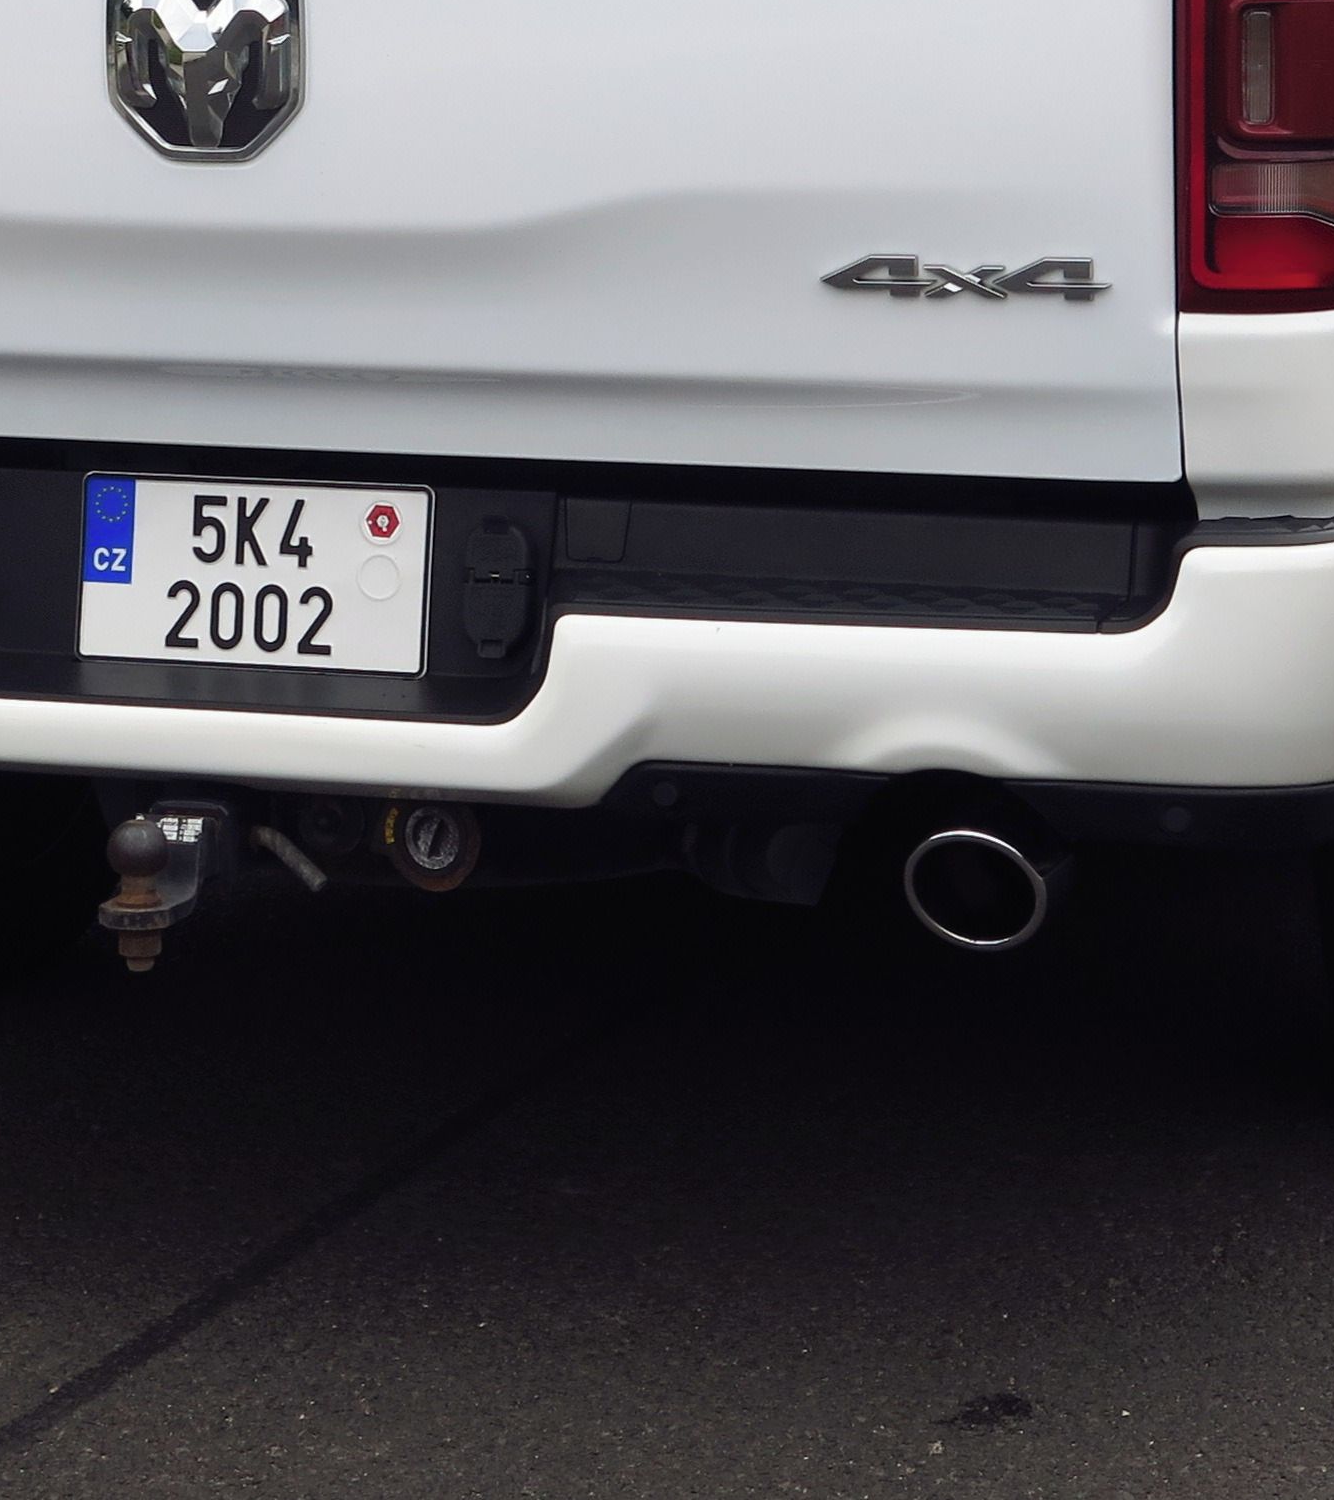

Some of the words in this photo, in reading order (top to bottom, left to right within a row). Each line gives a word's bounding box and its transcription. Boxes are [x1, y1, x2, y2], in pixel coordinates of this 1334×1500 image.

[92, 546, 127, 572] CZ
[191, 494, 314, 568] 5K4
[163, 579, 335, 656] 2002
